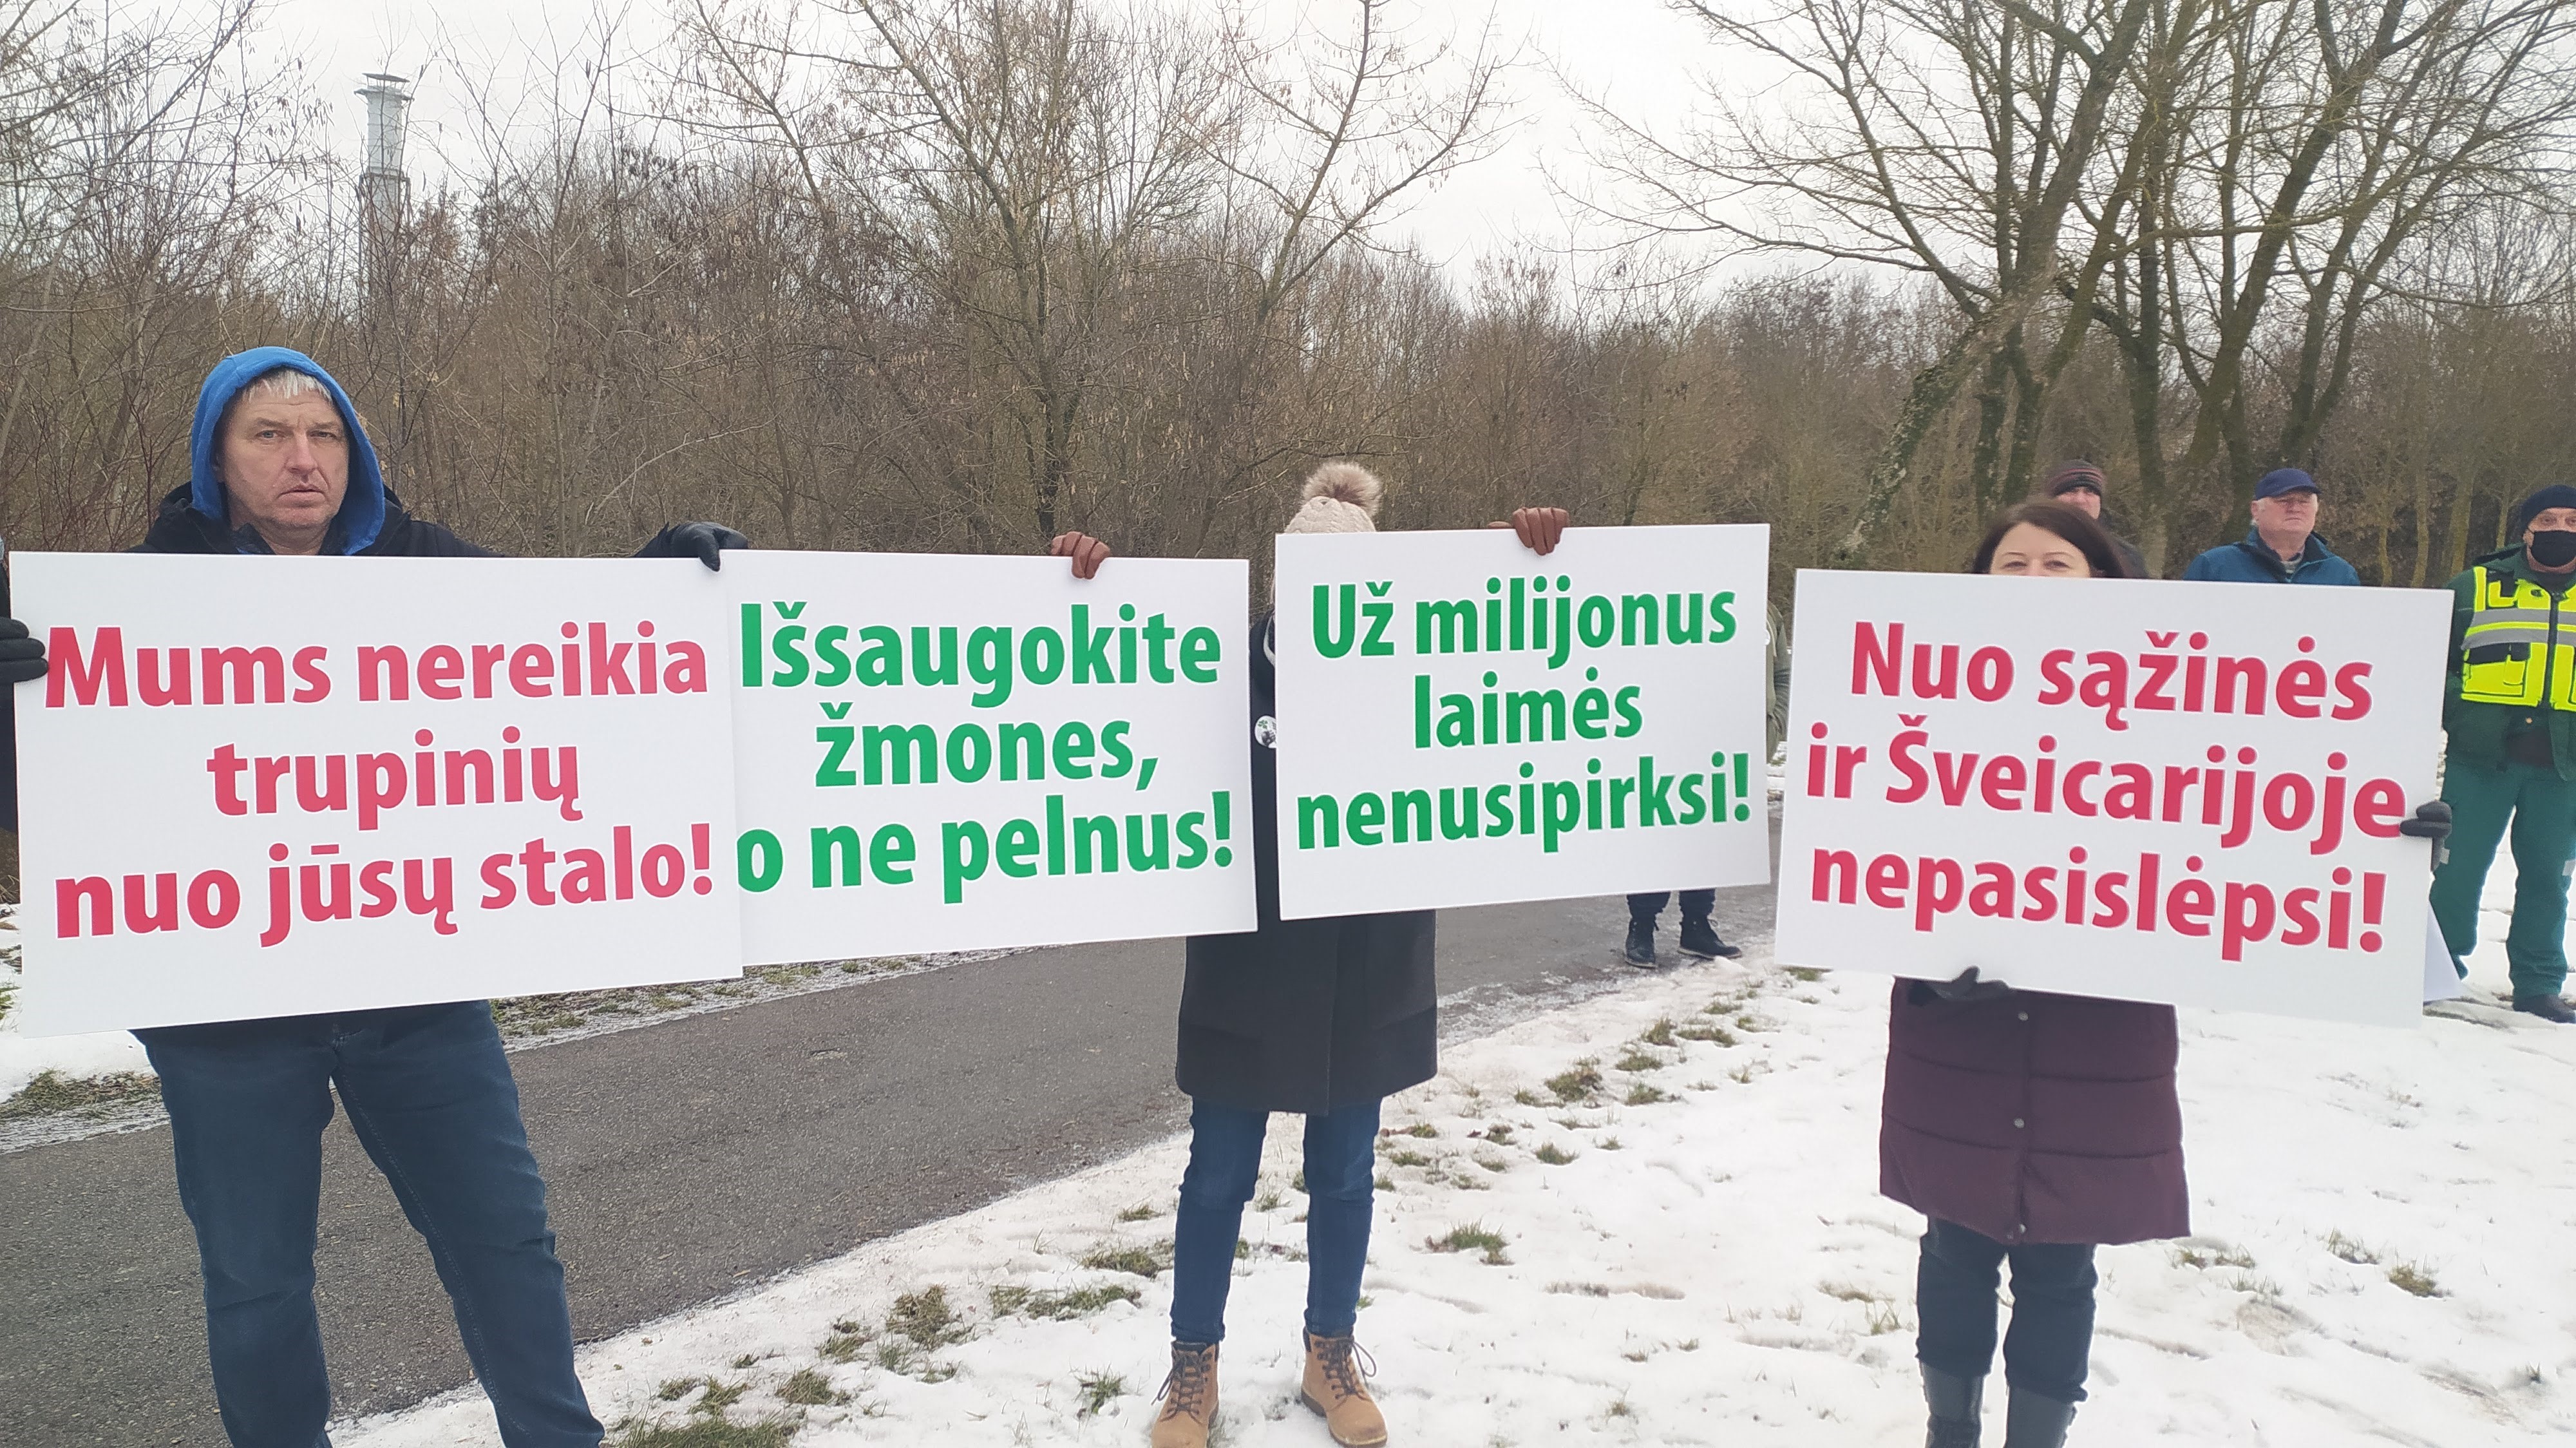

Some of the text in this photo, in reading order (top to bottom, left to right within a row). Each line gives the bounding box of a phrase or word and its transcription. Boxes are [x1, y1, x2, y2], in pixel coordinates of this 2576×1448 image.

[46, 620, 707, 708] Mums nereikia
[740, 601, 1220, 709] Išsaugokite
[1313, 575, 1736, 670] Už milijonus
[1415, 667, 1642, 748] laimės
[1852, 622, 2371, 731] Nuo sąžinės
[207, 726, 583, 831] trupinių
[815, 702, 1157, 790] žmones,
[1807, 714, 2405, 855] ir Šveicarijoje
[737, 791, 1232, 904] o ne pelnus!
[1298, 752, 1750, 853] nenusipirksi!
[56, 823, 712, 948] nuo jūsų stalo!
[1812, 849, 2385, 962] nepasislėpsi!
